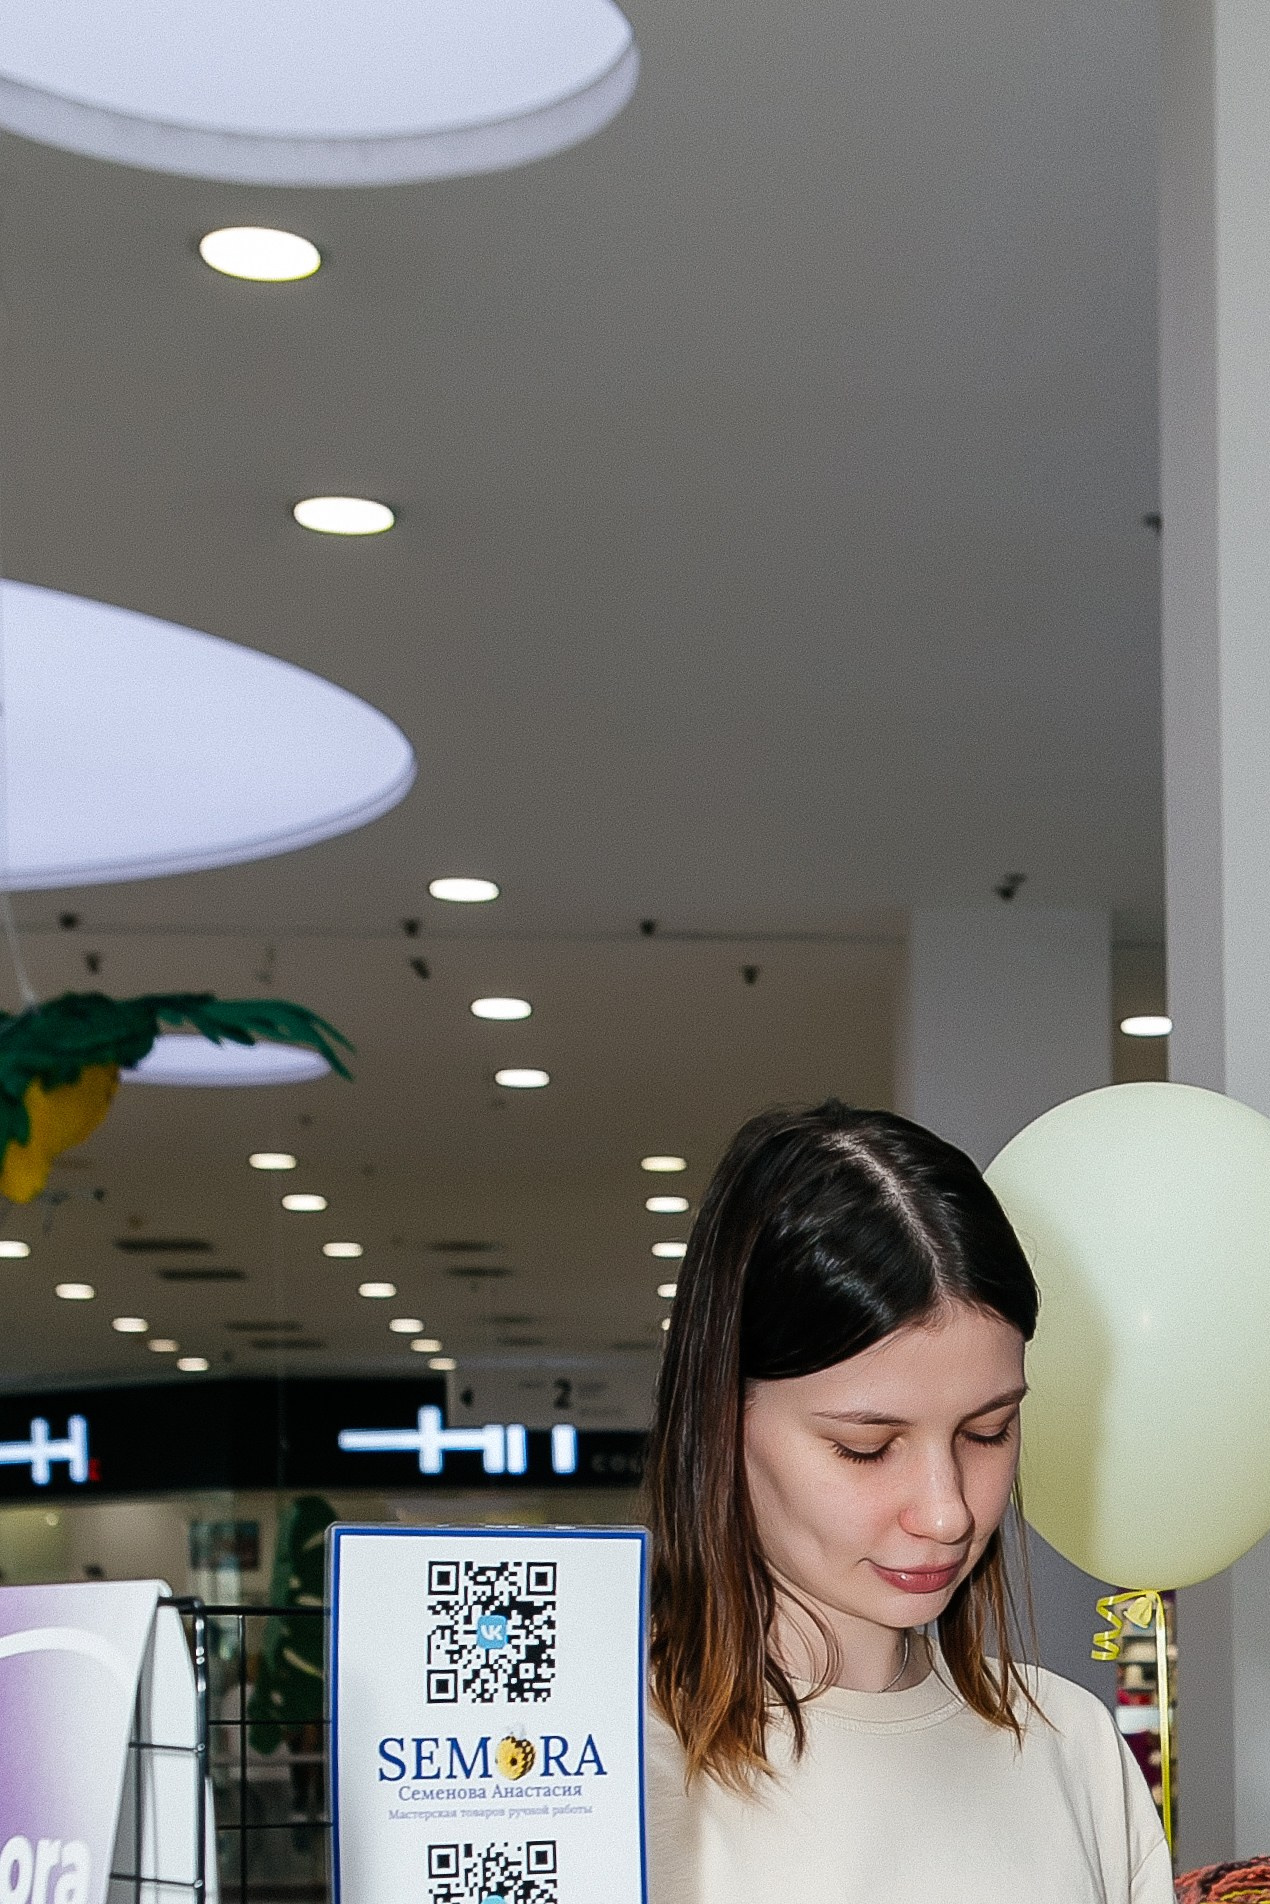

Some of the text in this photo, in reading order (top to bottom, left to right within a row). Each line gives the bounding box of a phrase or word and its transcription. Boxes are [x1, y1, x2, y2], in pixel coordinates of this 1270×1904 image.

[398, 1784, 583, 1801] Семенова Анастасия
[388, 1803, 594, 1822] Мастерская товаров ручной работы
